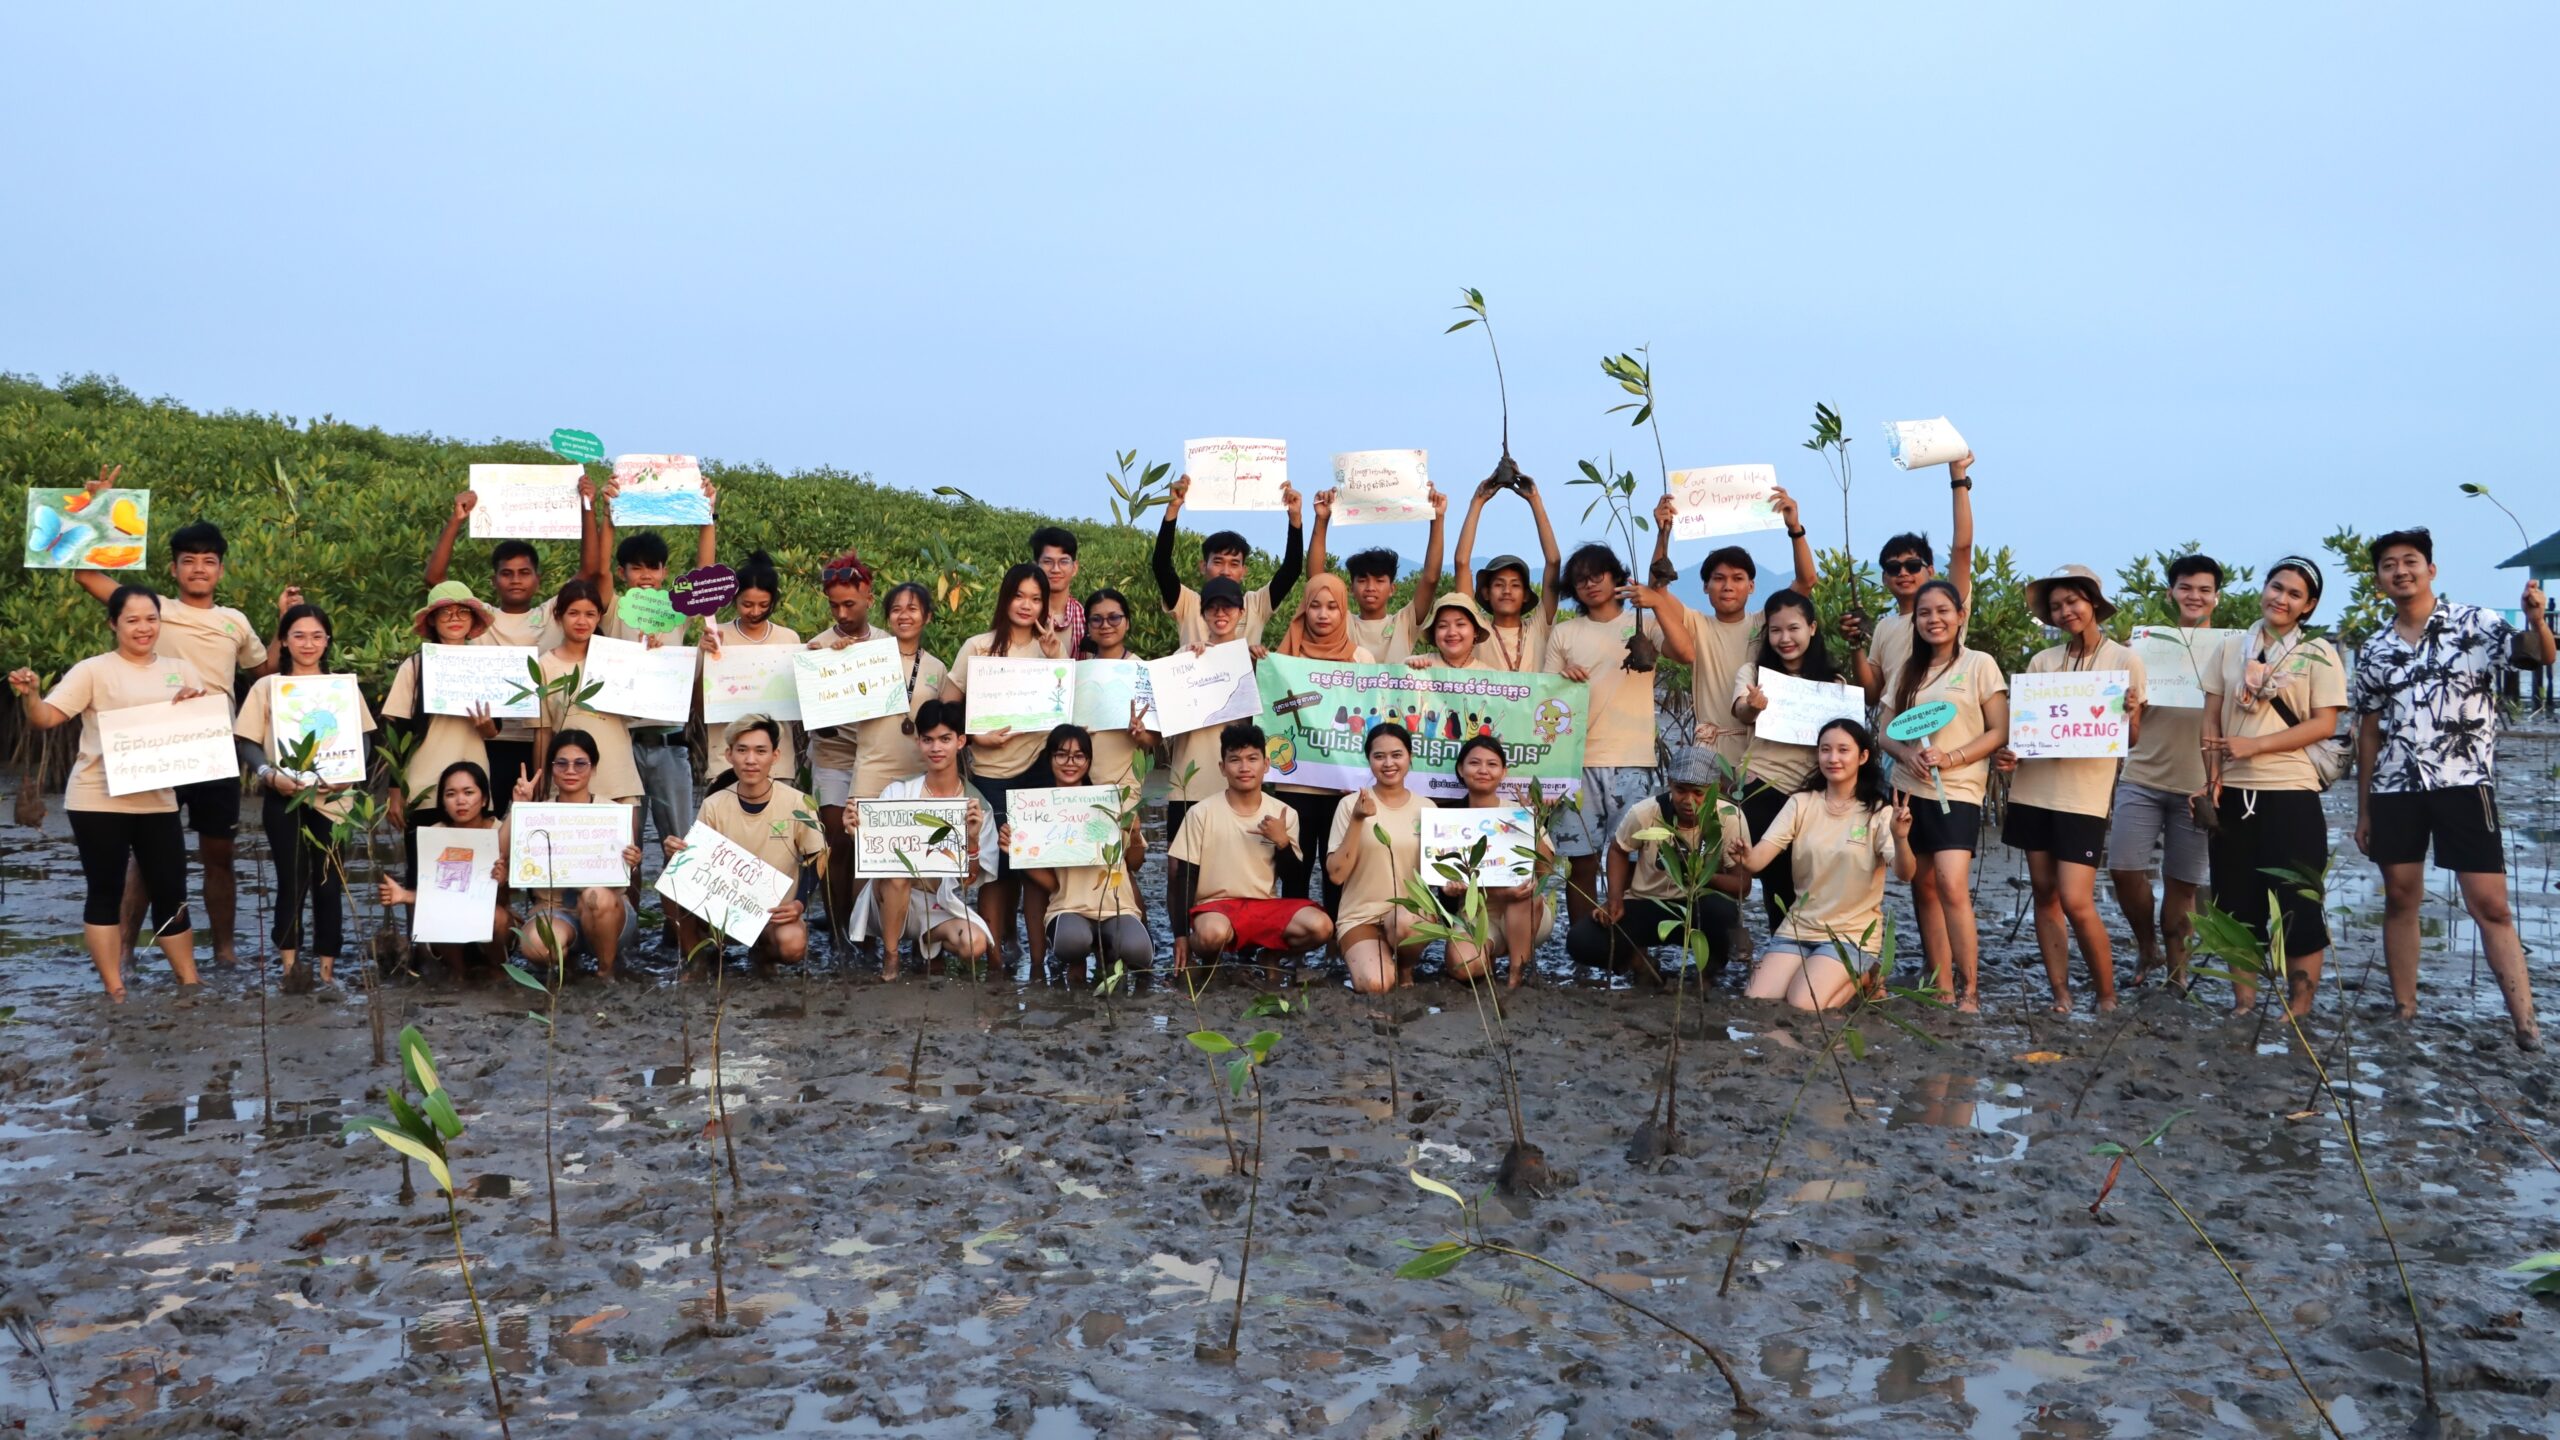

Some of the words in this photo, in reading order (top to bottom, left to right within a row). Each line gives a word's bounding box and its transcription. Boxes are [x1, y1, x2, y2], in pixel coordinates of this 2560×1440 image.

[1309, 671, 1354, 689] កម្មវិធី
[2024, 684, 2095, 702] SHARING
[2049, 704, 2069, 718] IS
[2051, 722, 2119, 739] CARING
[1017, 791, 1046, 810] Save
[1057, 809, 1091, 823] Save
[865, 836, 885, 854] IS
